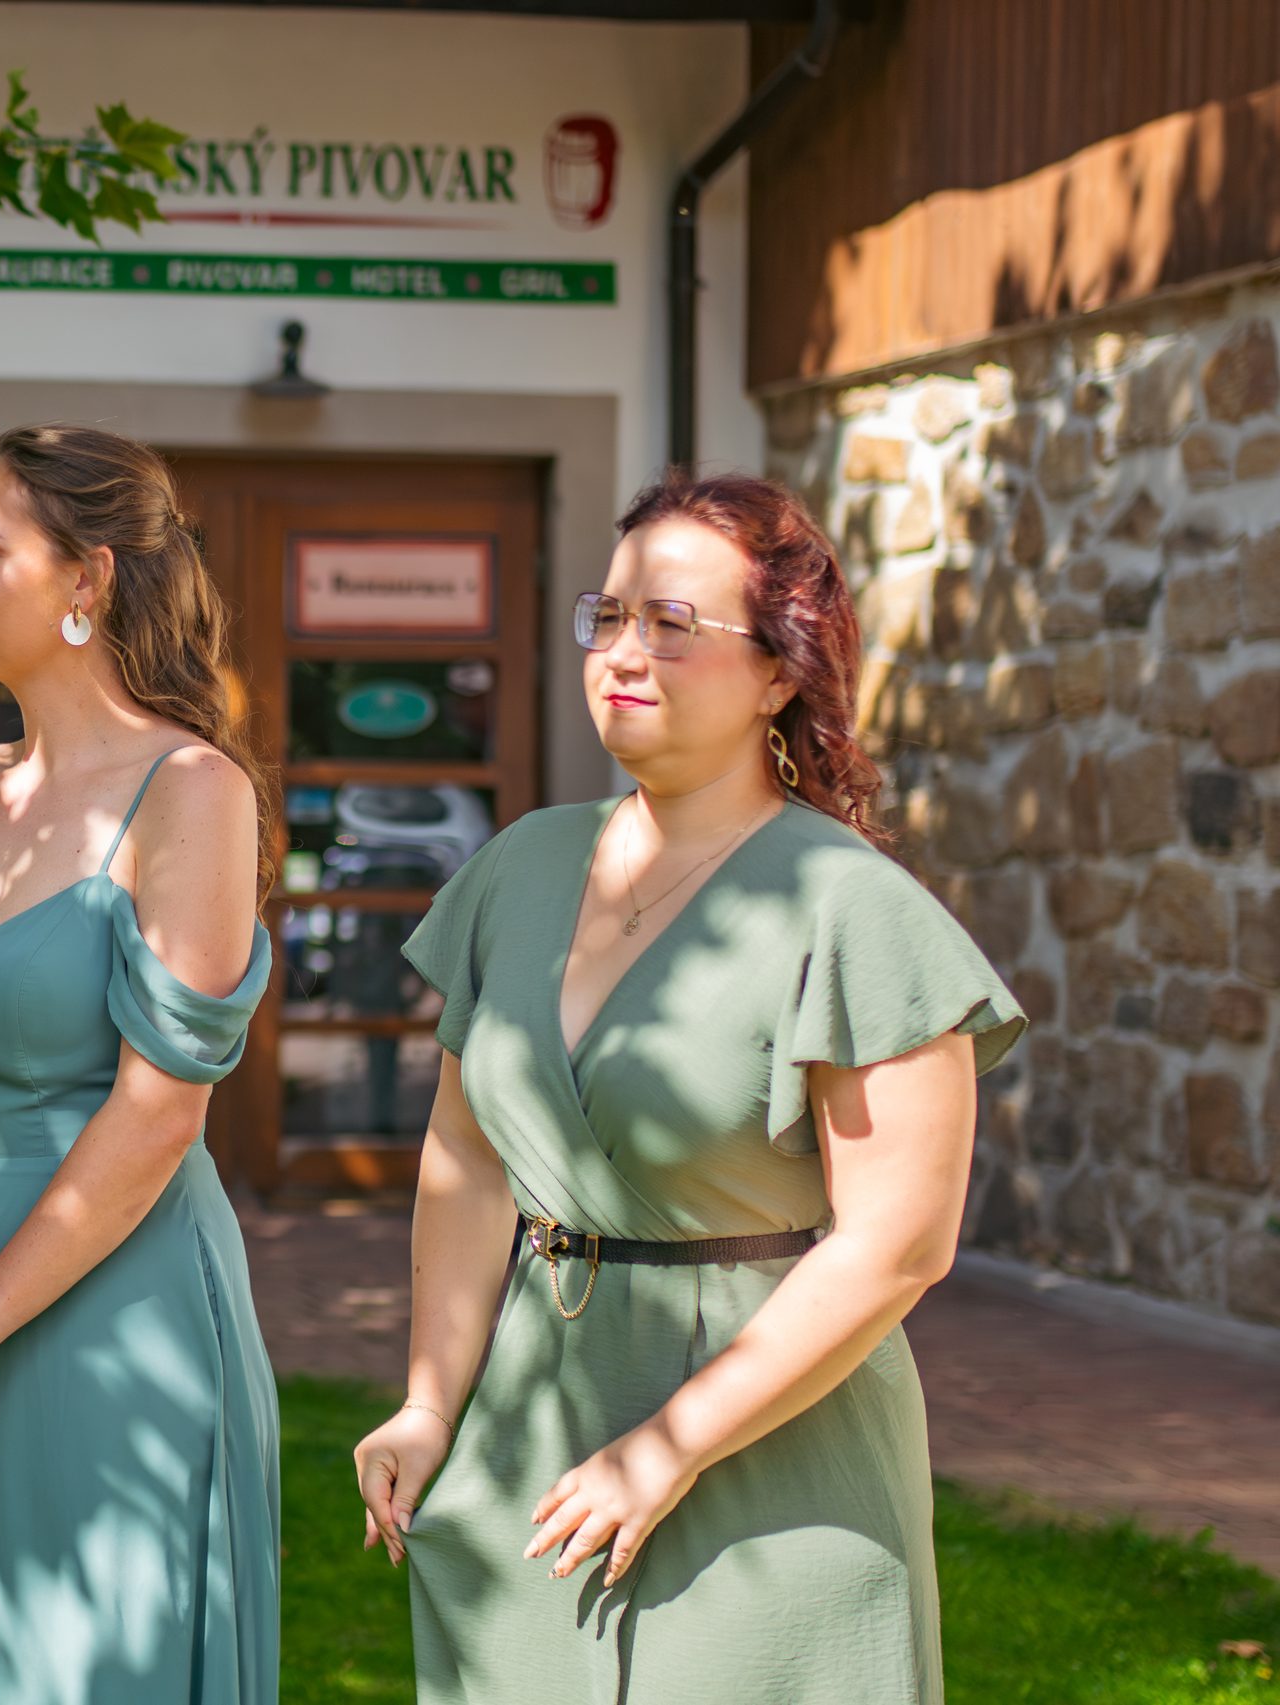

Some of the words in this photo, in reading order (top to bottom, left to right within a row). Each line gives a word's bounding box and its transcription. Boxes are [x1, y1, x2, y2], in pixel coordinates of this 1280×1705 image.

[287, 141, 516, 203] PIVOVAR
[166, 259, 298, 291] PIVOVAR
[350, 264, 448, 296] HOTEL
[498, 268, 570, 298] GRIL
